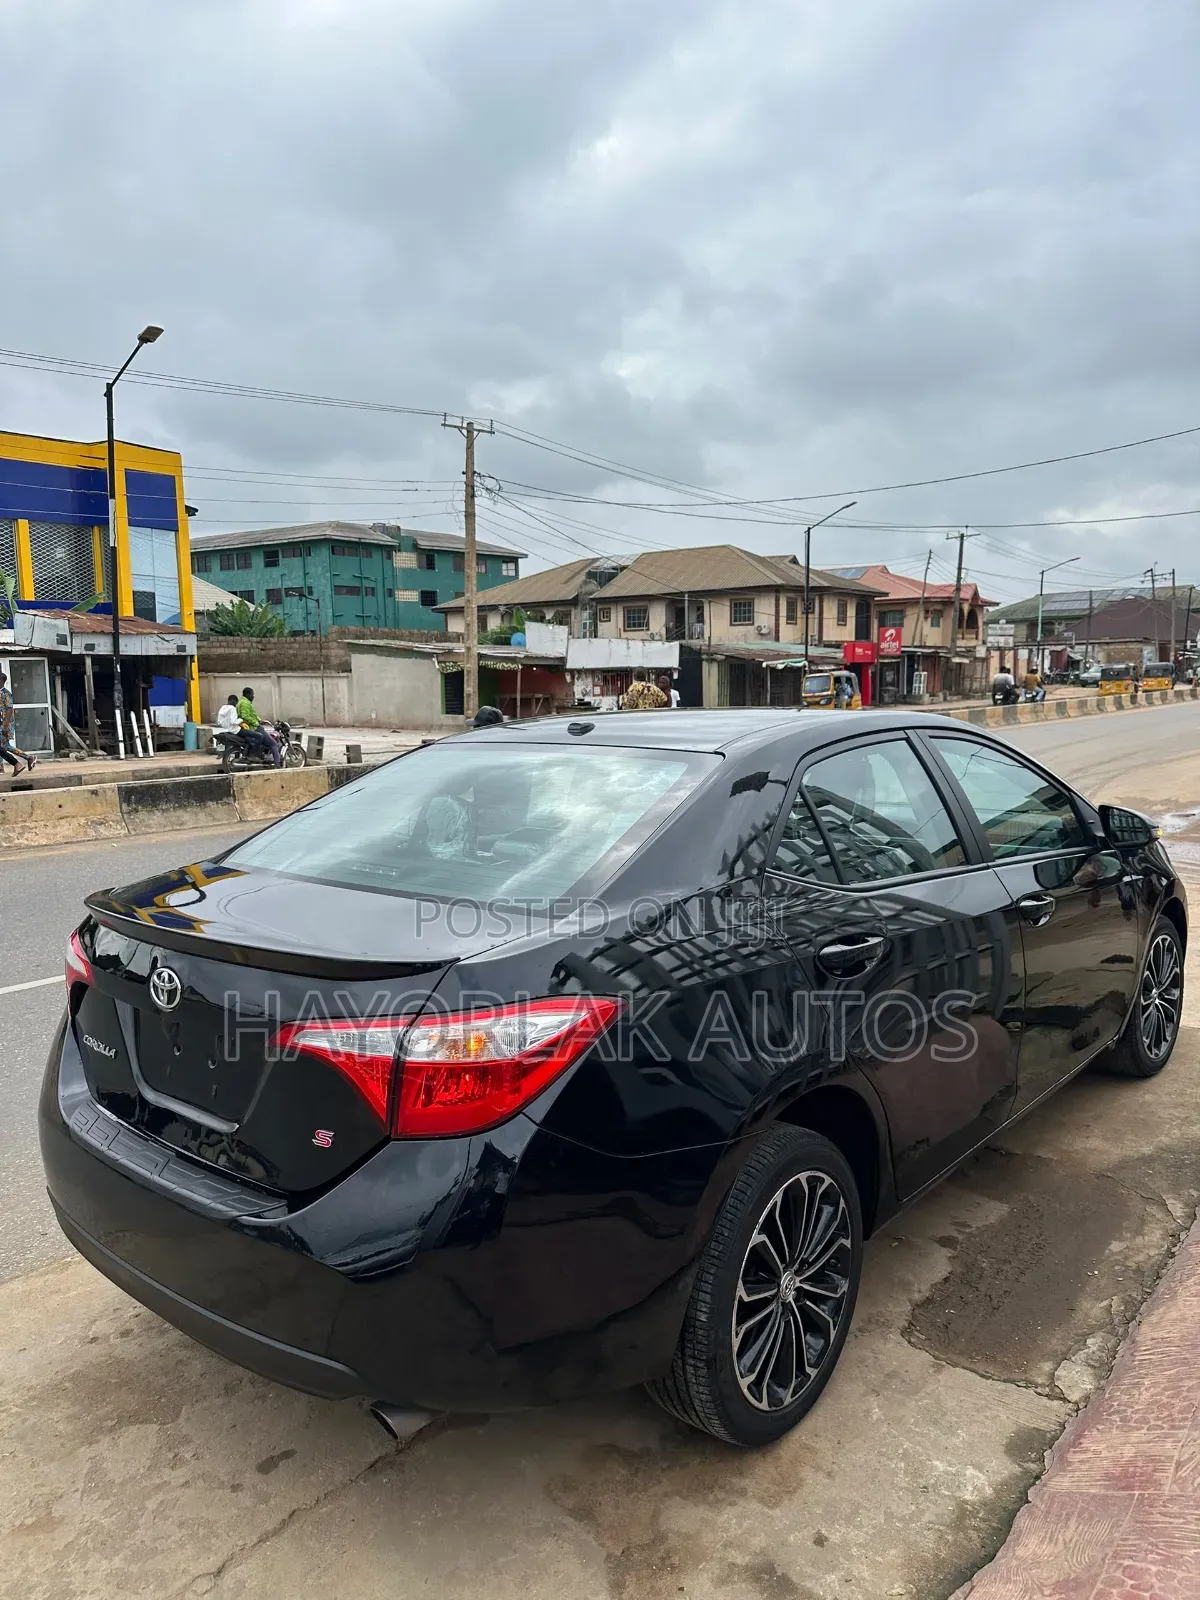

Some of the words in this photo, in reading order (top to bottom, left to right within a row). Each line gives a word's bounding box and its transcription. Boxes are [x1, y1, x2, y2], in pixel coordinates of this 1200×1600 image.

[880, 640, 899, 649] airtel
[83, 1034, 116, 1059] COROLLA
[312, 1129, 335, 1148] S
